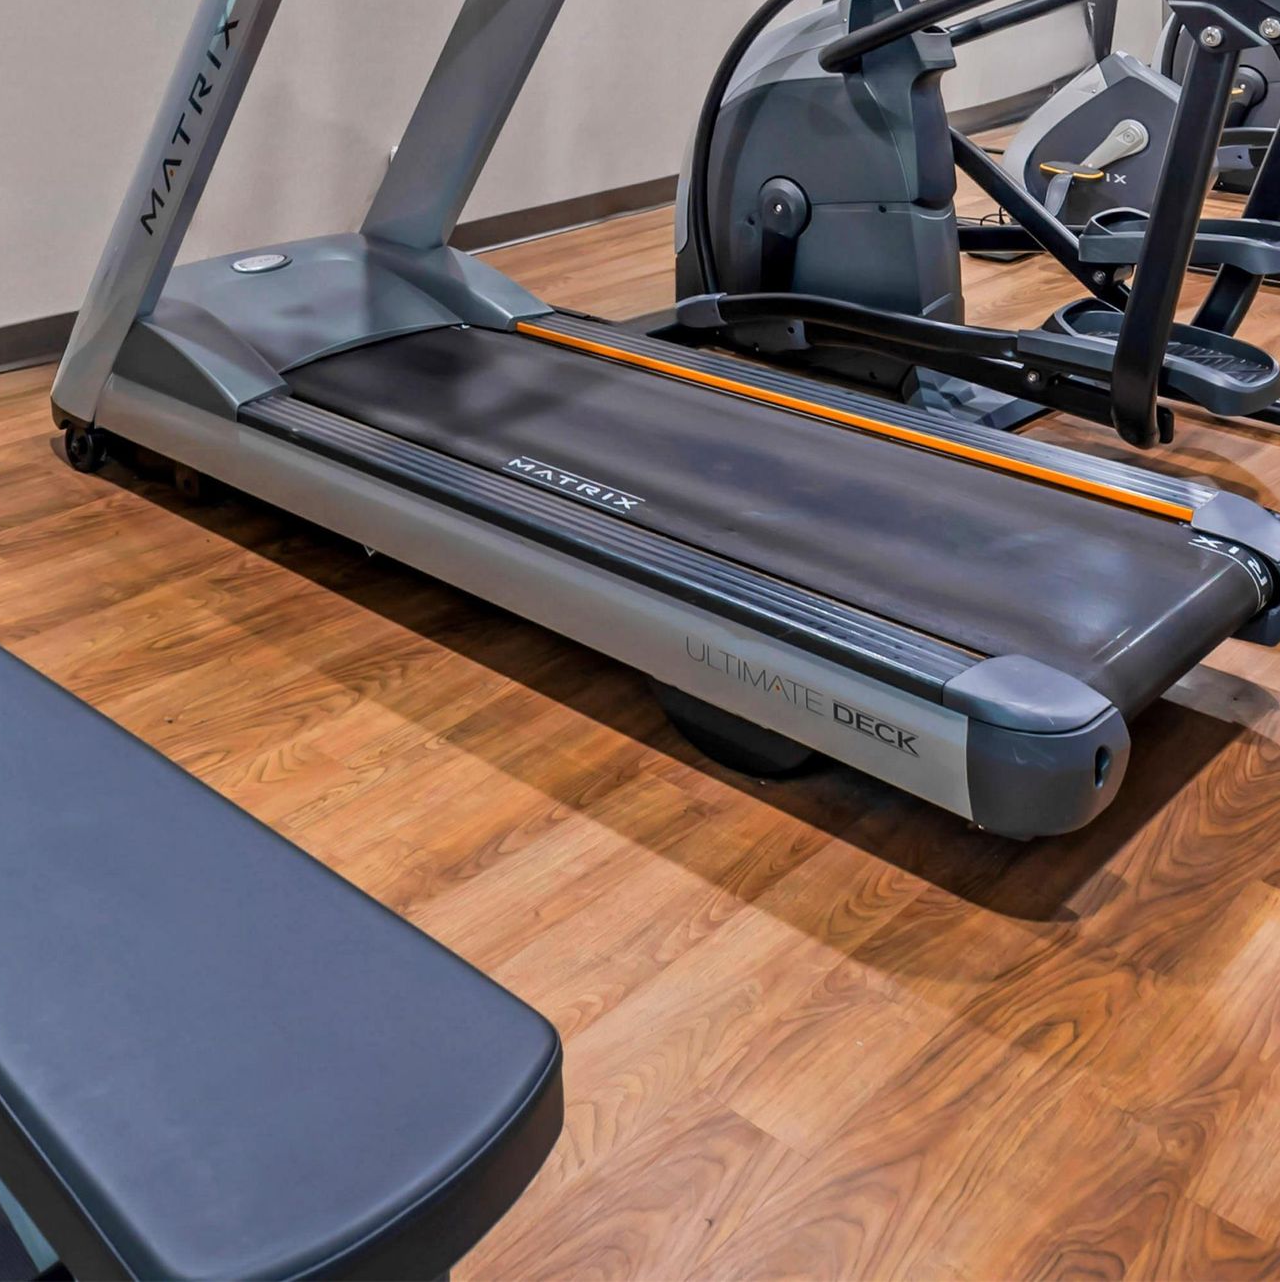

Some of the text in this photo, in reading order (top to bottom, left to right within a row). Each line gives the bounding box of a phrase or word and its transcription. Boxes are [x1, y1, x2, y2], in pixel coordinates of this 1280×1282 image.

[140, 19, 240, 236] MATRIX
[508, 458, 640, 510] MATRIX
[685, 636, 919, 756] ULTIMATE DECK
